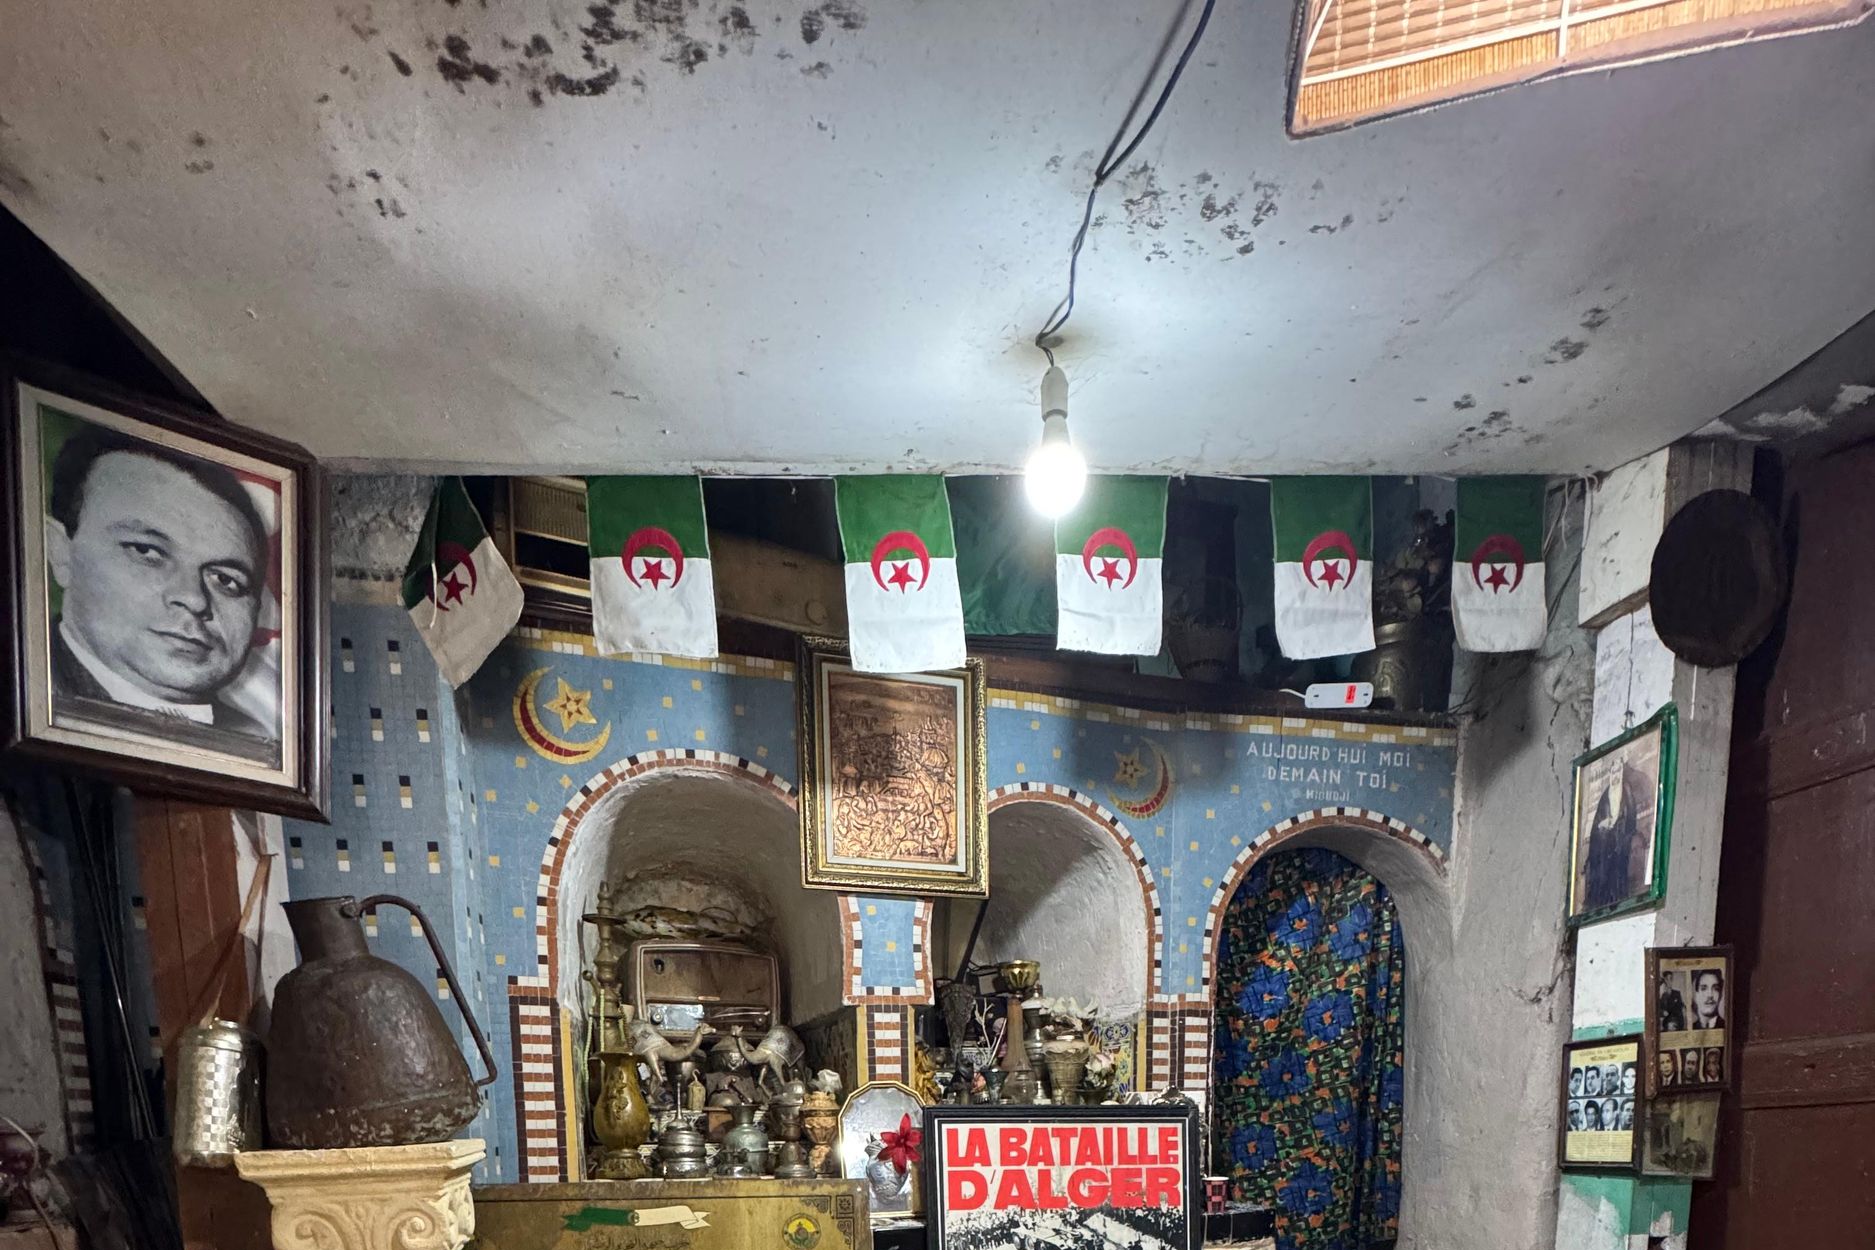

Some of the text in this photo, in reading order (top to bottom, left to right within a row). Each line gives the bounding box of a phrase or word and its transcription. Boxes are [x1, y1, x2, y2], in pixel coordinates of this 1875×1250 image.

[1266, 765, 1342, 785] DEMAIN
[946, 1126, 1179, 1168] LA BATAILLE
[947, 1166, 1182, 1211] D'ALGER
